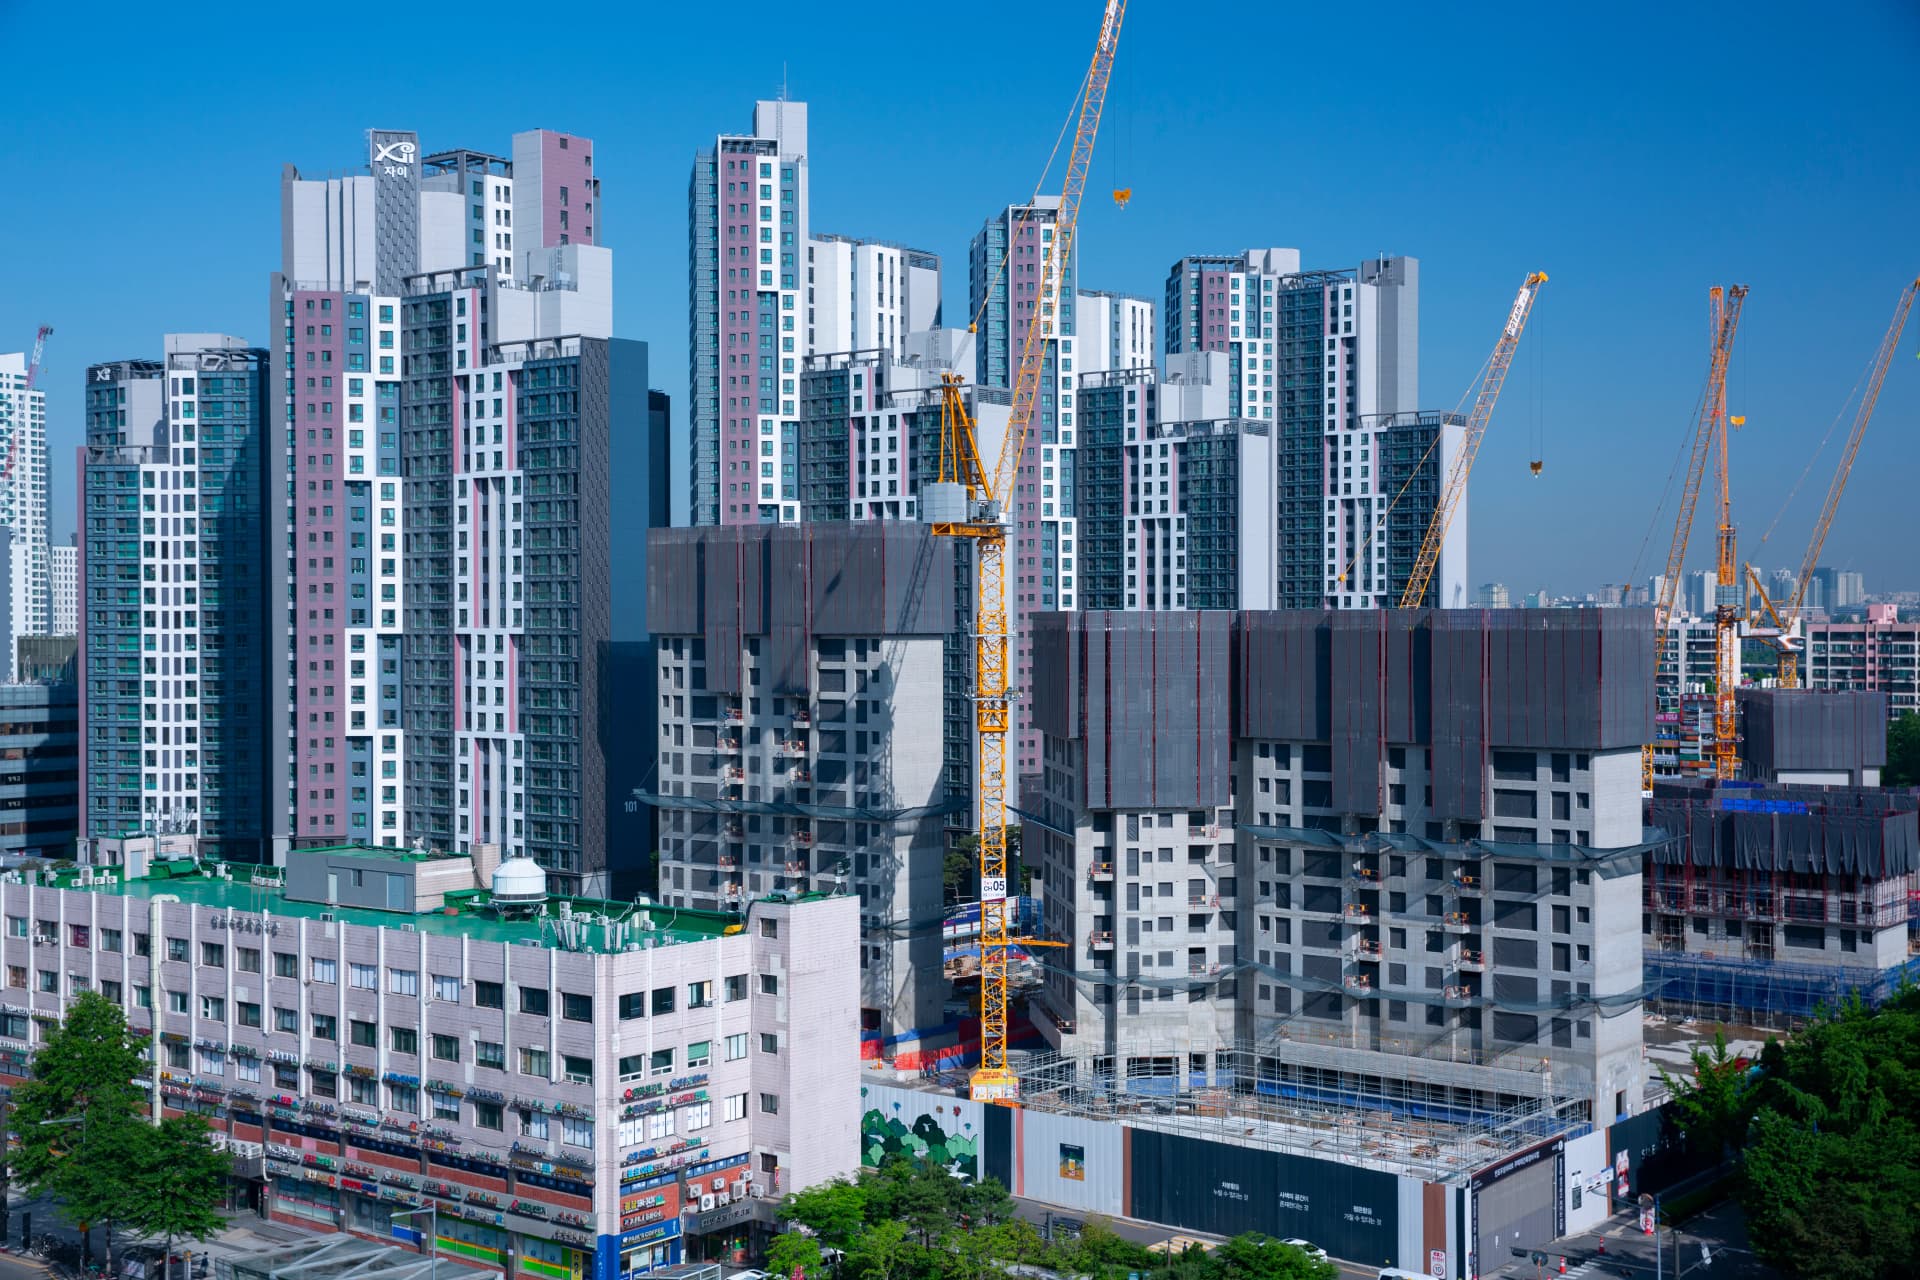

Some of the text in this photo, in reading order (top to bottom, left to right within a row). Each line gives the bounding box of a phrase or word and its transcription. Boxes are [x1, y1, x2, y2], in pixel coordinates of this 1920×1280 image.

[384, 166, 408, 178] 자이
[624, 800, 638, 813] 101
[993, 880, 1005, 891] 05
